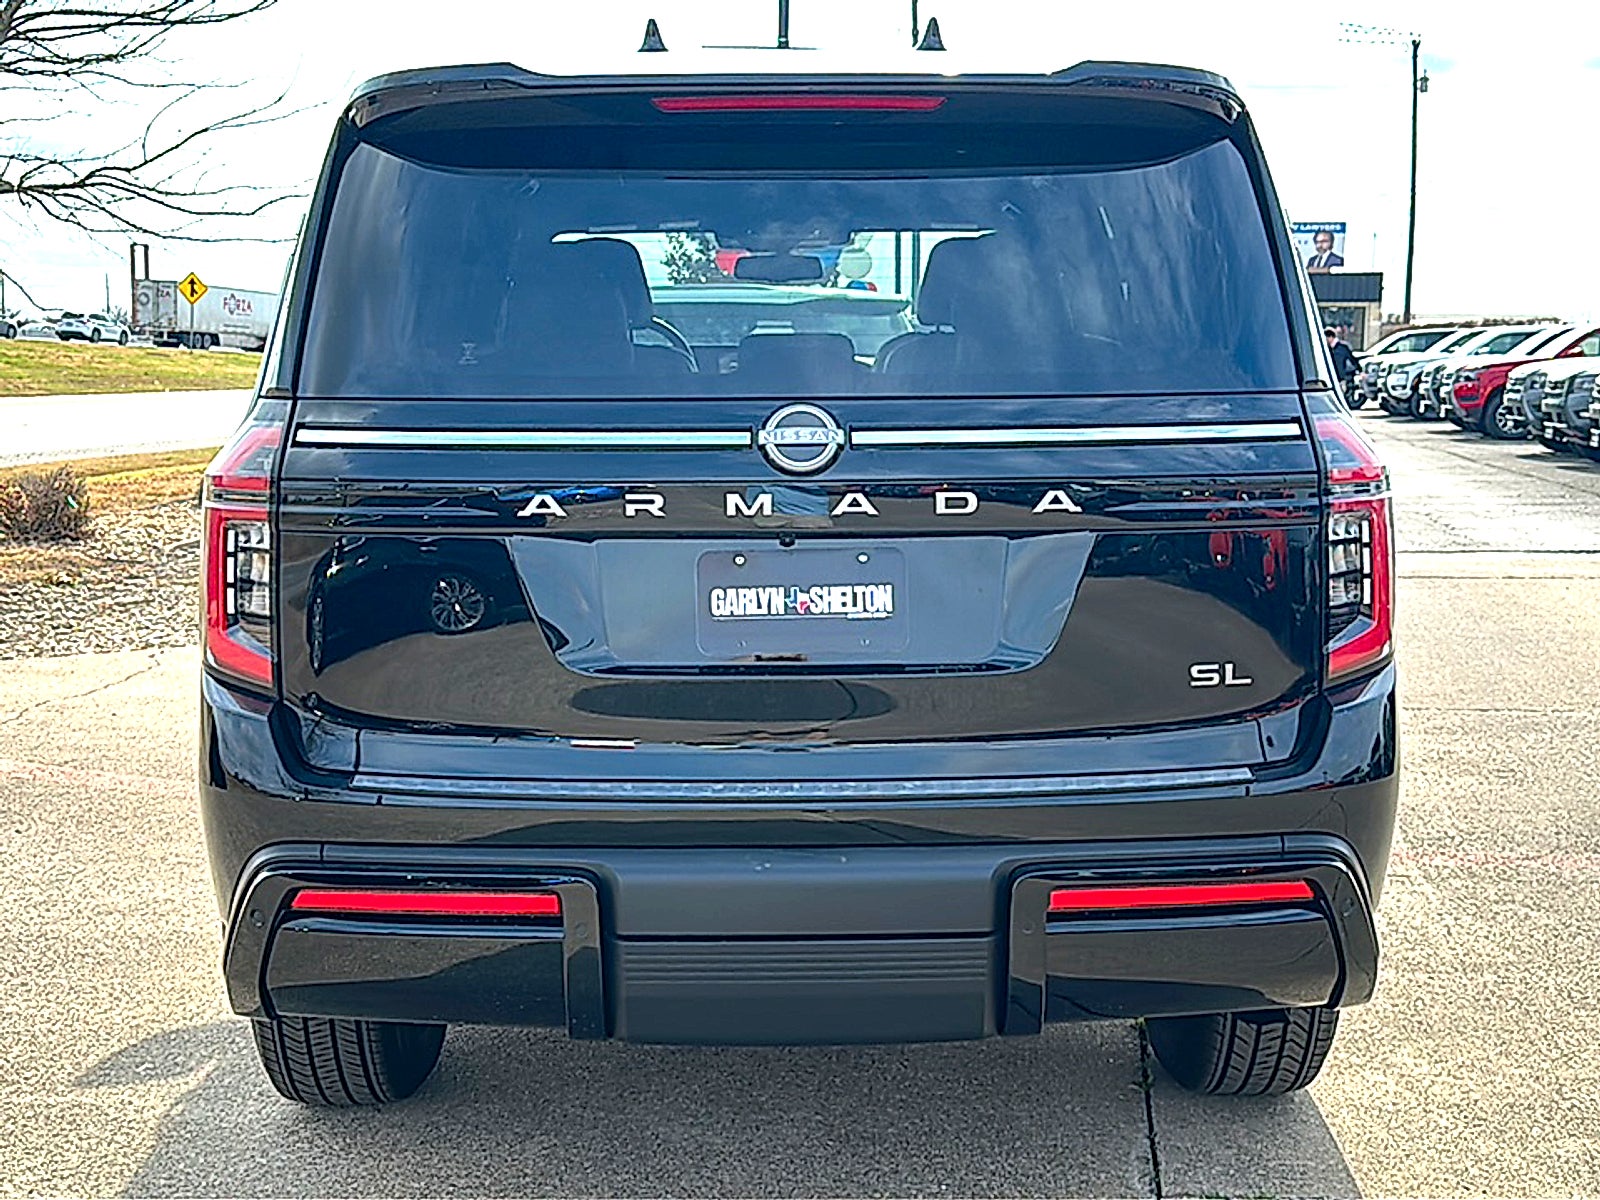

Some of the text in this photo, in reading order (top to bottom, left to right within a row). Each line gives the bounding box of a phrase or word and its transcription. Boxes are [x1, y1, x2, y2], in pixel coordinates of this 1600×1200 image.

[761, 429, 841, 442] NISSAN
[516, 489, 1083, 517] ARMADA
[710, 584, 893, 616] GARLYN SHELTON
[1190, 663, 1252, 686] SL
